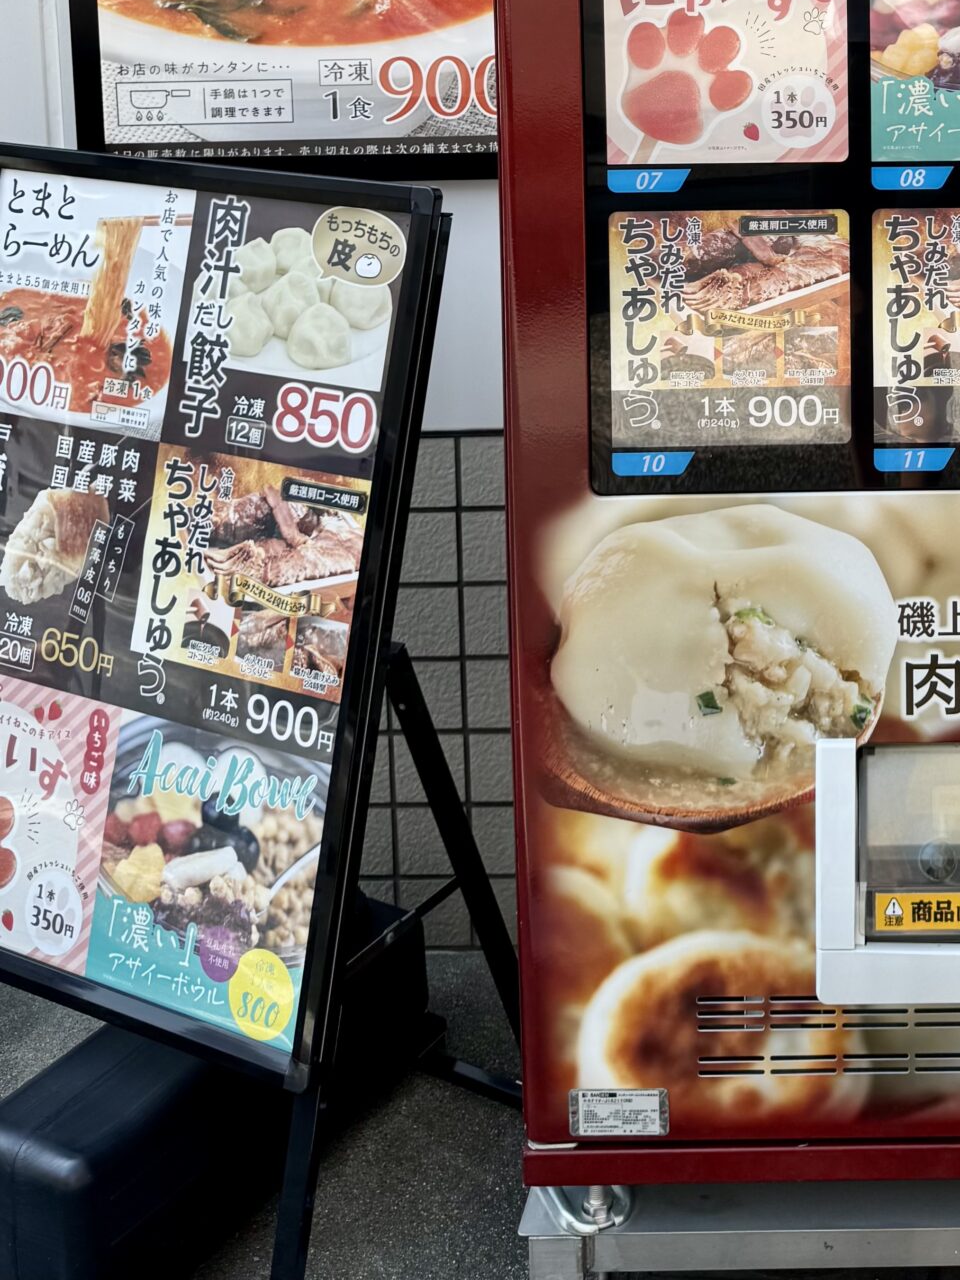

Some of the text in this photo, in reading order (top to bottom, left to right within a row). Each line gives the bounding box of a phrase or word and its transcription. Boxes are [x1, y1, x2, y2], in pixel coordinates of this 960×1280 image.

[322, 62, 369, 83] 冷凍
[210, 88, 285, 101] 手鍋は1つで
[324, 90, 373, 121] 1食
[210, 105, 286, 119] 調理できます
[771, 110, 827, 129] 350円
[636, 172, 663, 190] 07
[900, 169, 925, 187] 08
[8, 179, 76, 220] とまと
[326, 213, 401, 258] もっちもちの
[749, 220, 828, 231] 厳選肩ロース使用
[3, 223, 100, 267] らーめん
[327, 238, 352, 272] 皮
[146, 190, 179, 337] お店で人気の味が
[660, 219, 685, 314] しみだれ
[125, 281, 146, 369] カンタンに
[105, 379, 128, 396] 冷凍
[229, 421, 262, 445] 12個
[275, 382, 377, 455] 850
[697, 418, 740, 430] (約240g)
[55, 435, 141, 474] 国産豚肉
[642, 454, 665, 472] 10
[903, 452, 925, 469] 11
[51, 464, 137, 503] 国産野菜
[288, 483, 360, 508] 厳選肩ロース使用
[185, 465, 218, 576] しみだれ
[103, 524, 125, 594] もっちり
[235, 578, 306, 612] しみだれ2段仕込み
[41, 627, 114, 677] 650円
[209, 684, 239, 712] 1本
[202, 708, 239, 728] (約240g)
[246, 693, 335, 753] 900円
[83, 711, 107, 790] いちご味
[36, 883, 57, 901] 1本
[30, 905, 75, 940] 350円
[108, 898, 199, 968] 「濃い」
[884, 914, 904, 926] 注意
[108, 951, 226, 1006] アサイーボウル
[236, 993, 280, 1029] 800
